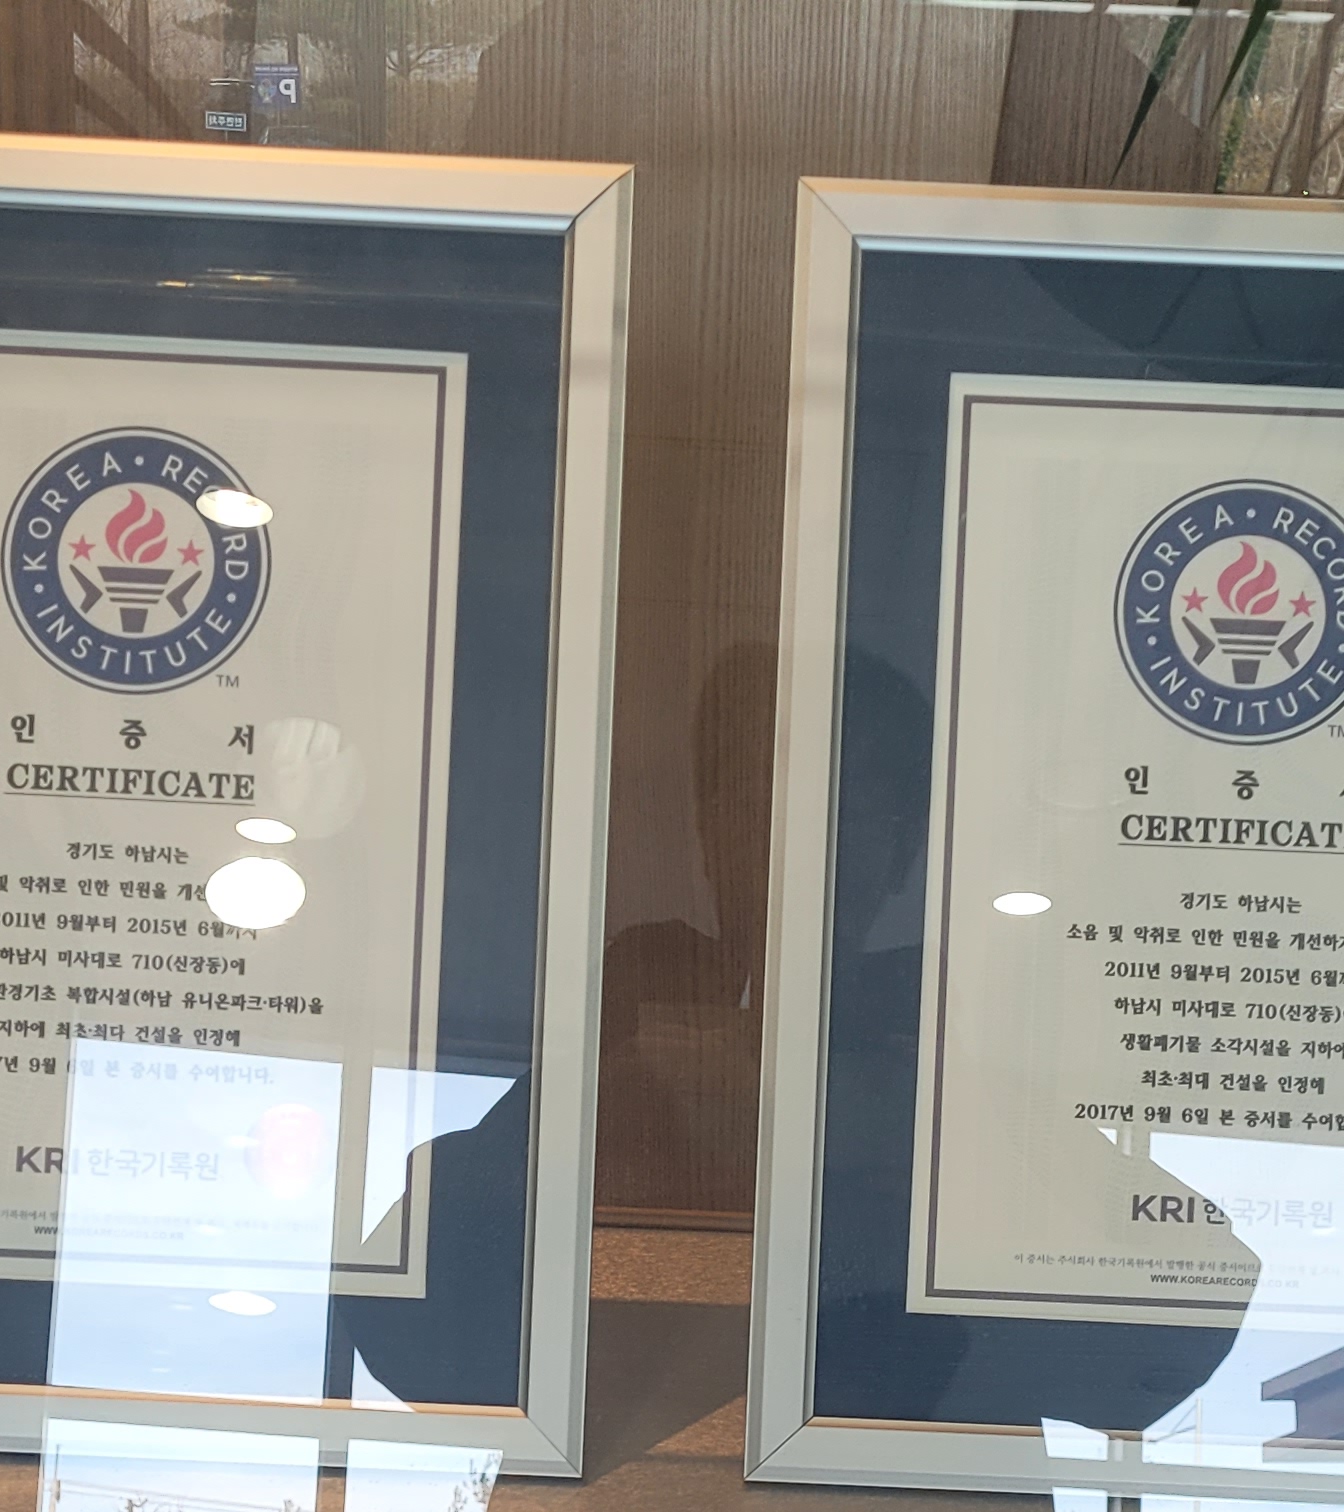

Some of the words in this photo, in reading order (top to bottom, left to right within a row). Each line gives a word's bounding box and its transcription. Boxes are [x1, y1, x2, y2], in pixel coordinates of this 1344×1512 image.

[23, 452, 124, 572] KOREA
[162, 453, 250, 581] RERD
[1135, 504, 1234, 624] KOREA
[36, 603, 233, 675] INSTITUTE
[217, 675, 240, 688] TM
[1149, 657, 1344, 726] INSTITUTE
[5, 762, 255, 801] CERTIFICATE
[66, 841, 115, 861] 경기도
[124, 844, 189, 865] 하남시는
[19, 875, 68, 895] 악취로
[77, 878, 110, 897] 인한
[119, 880, 167, 900] 민원을
[1179, 892, 1228, 911] 경기도
[1237, 894, 1303, 914] 하남시는
[56, 914, 117, 934] 9월부터
[127, 917, 187, 937] 2015년
[1066, 923, 1099, 942] 소음
[1108, 924, 1123, 943] 및
[1133, 925, 1182, 945] 악취로
[1191, 928, 1224, 947] 인한
[1232, 930, 1281, 949] 민원을
[57, 949, 123, 970] 미사대로
[131, 954, 246, 976] 710(신장동)에
[1104, 961, 1160, 980] 2011년
[1170, 963, 1230, 984] 9월부터
[1240, 967, 1300, 986] 2015년
[66, 986, 173, 1008] 복합시설(하남
[1114, 996, 1162, 1017] 하남시
[1171, 999, 1237, 1019] 미사대로
[134, 1025, 184, 1045] 건설을
[193, 1027, 241, 1047] 인정해
[1120, 1032, 1202, 1054] 생활폐기물
[1210, 1037, 1292, 1057] 소각시설을
[28, 1056, 57, 1076] 9월
[66, 1056, 97, 1078] 6일
[1141, 1069, 1210, 1090] 최초·최대
[1219, 1073, 1268, 1092] 건설을
[1277, 1075, 1325, 1095] 인정해
[1074, 1102, 1135, 1125] 2017년
[1143, 1105, 1172, 1125] 9월
[1180, 1106, 1210, 1127] 6일
[1218, 1108, 1236, 1127] 본
[1245, 1109, 1293, 1131] 증서를
[16, 1146, 78, 1174] KRI
[87, 1150, 220, 1182] 한국기록원
[1132, 1195, 1195, 1224] KRI
[1203, 1198, 1334, 1229] 한국기록원
